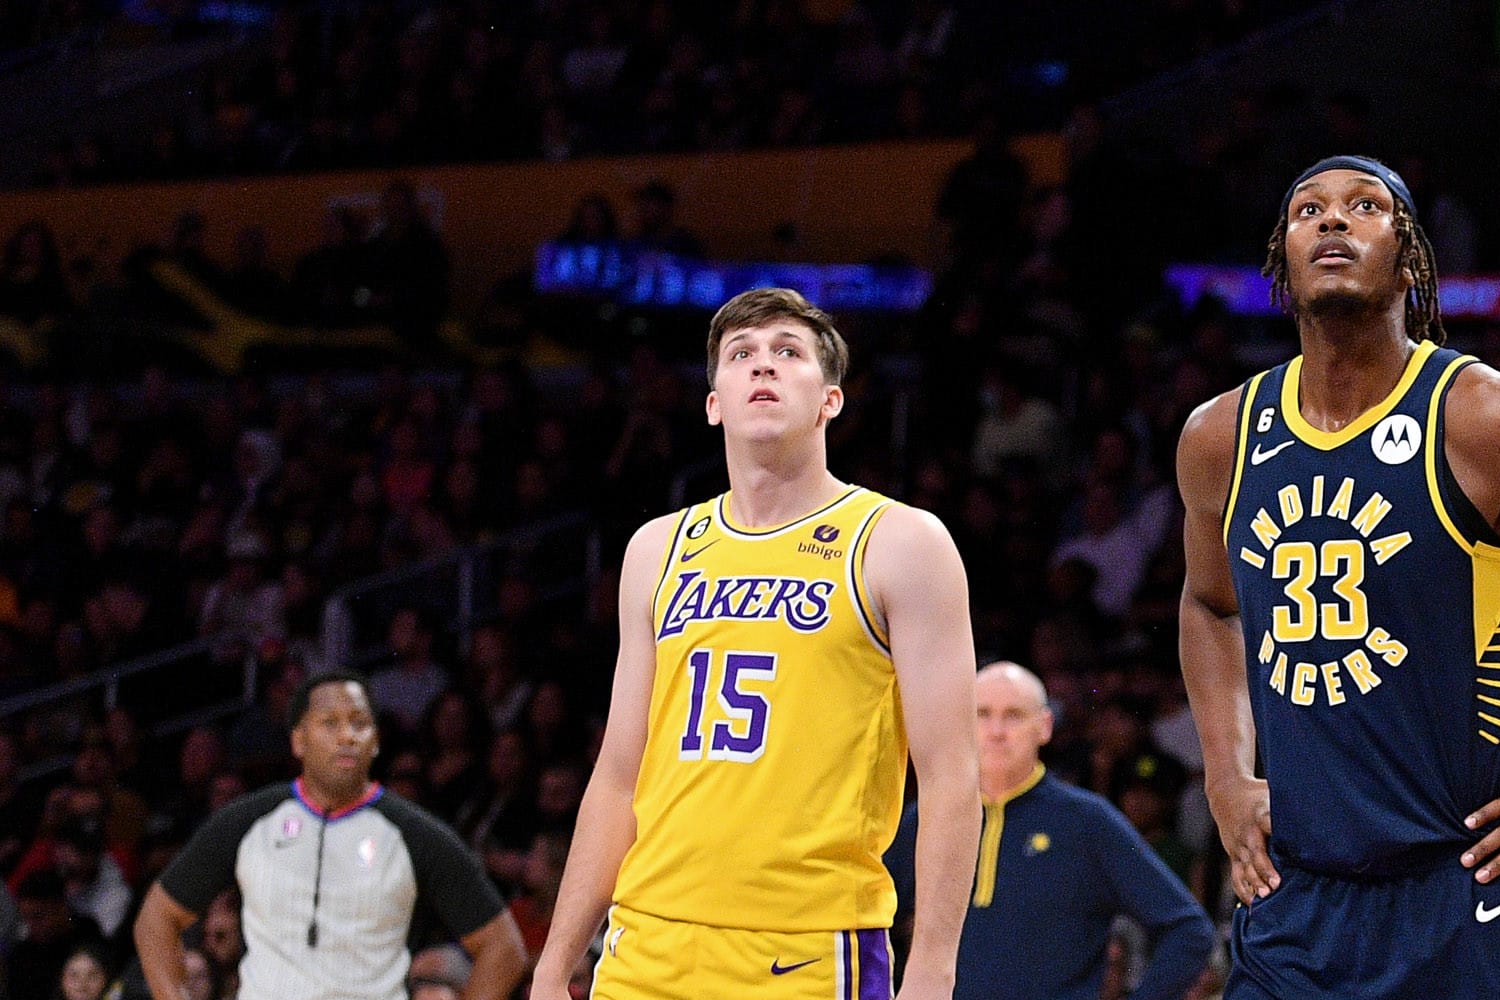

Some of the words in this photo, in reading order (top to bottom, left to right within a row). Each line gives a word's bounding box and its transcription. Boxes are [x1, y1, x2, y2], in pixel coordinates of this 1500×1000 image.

[1257, 407, 1275, 432] 6
[693, 518, 711, 539] 6
[797, 542, 843, 560] bibigo
[1240, 475, 1413, 570] INDIANA
[657, 569, 835, 642] LAKERS
[1271, 539, 1369, 643] 33
[1257, 627, 1409, 707] PACERS
[678, 647, 778, 764] 15
